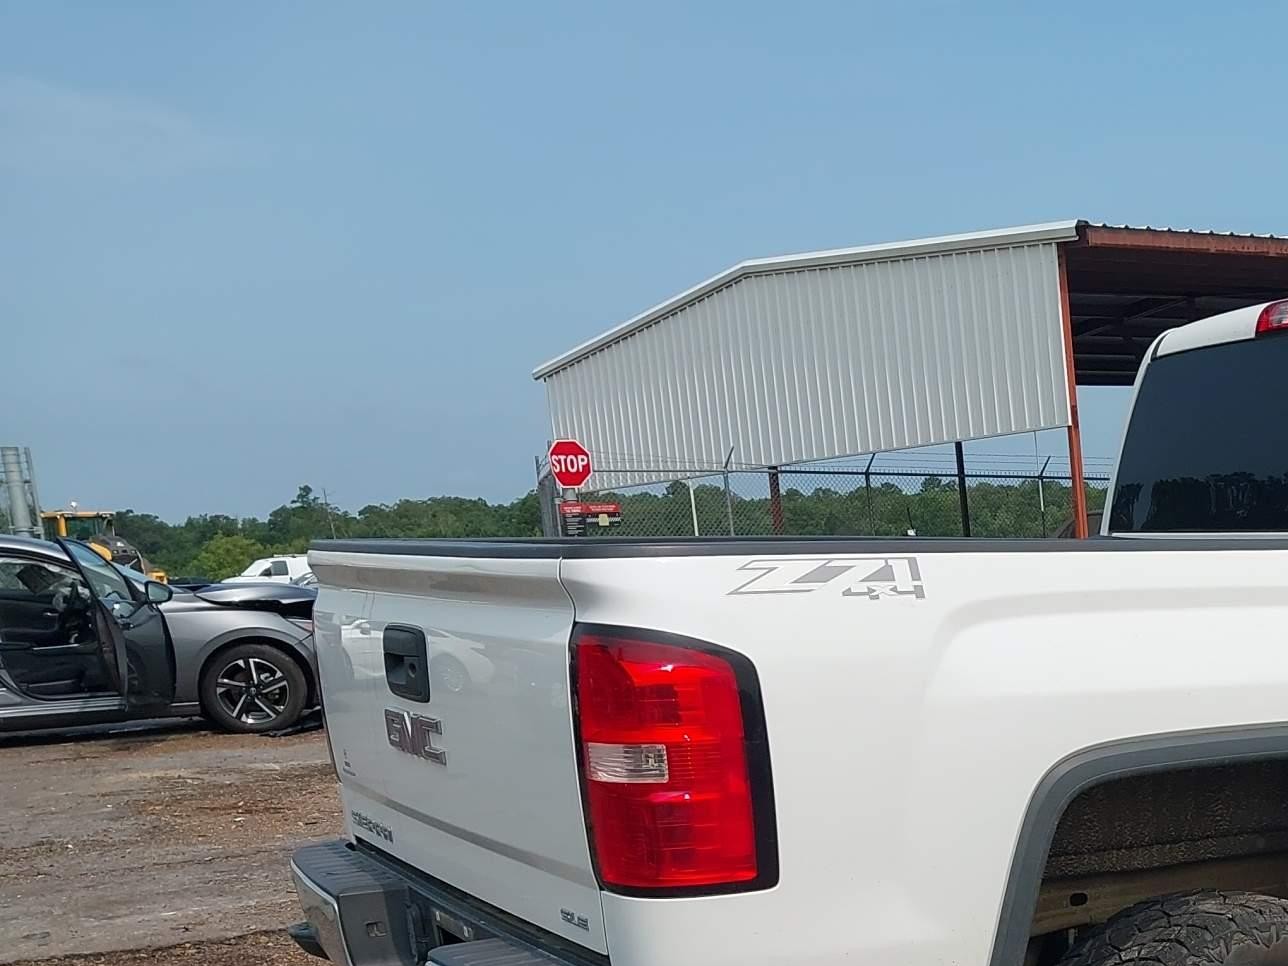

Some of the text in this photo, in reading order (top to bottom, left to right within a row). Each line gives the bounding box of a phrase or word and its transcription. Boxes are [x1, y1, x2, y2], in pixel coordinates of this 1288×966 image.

[551, 454, 588, 473] STOP
[726, 556, 922, 596] Z71
[384, 708, 447, 766] GMC
